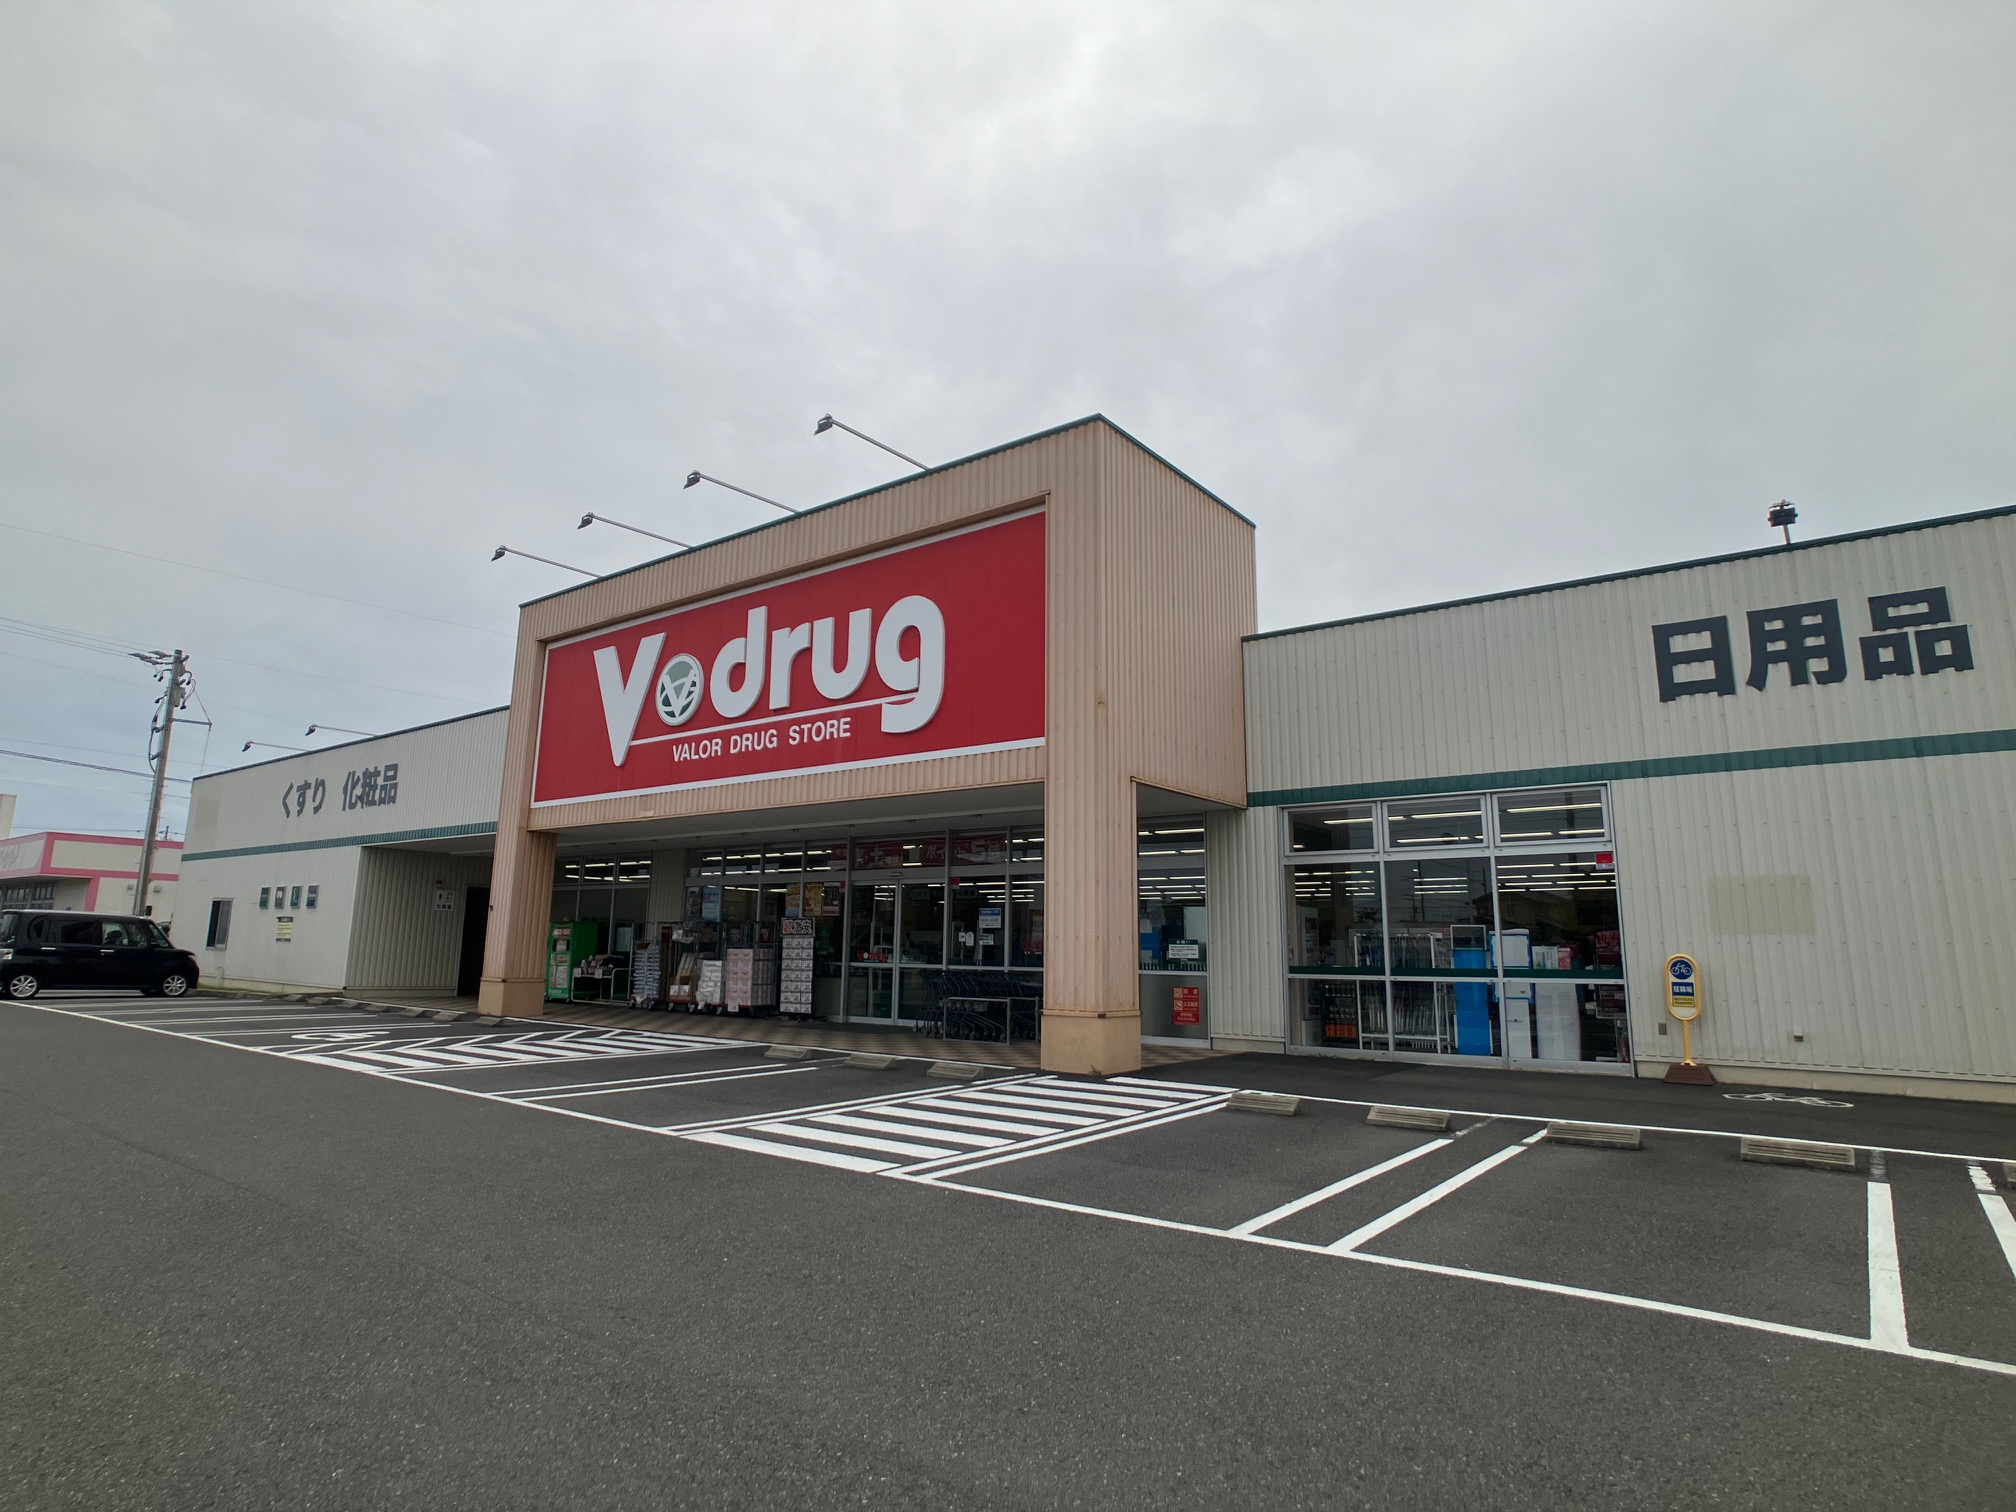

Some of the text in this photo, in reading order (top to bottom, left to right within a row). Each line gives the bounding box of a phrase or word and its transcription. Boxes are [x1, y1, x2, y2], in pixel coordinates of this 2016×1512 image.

[1652, 586, 1974, 702] 日用品
[672, 717, 851, 762] VALOR DRUG STORE
[281, 763, 399, 818] くすり 化粧品
